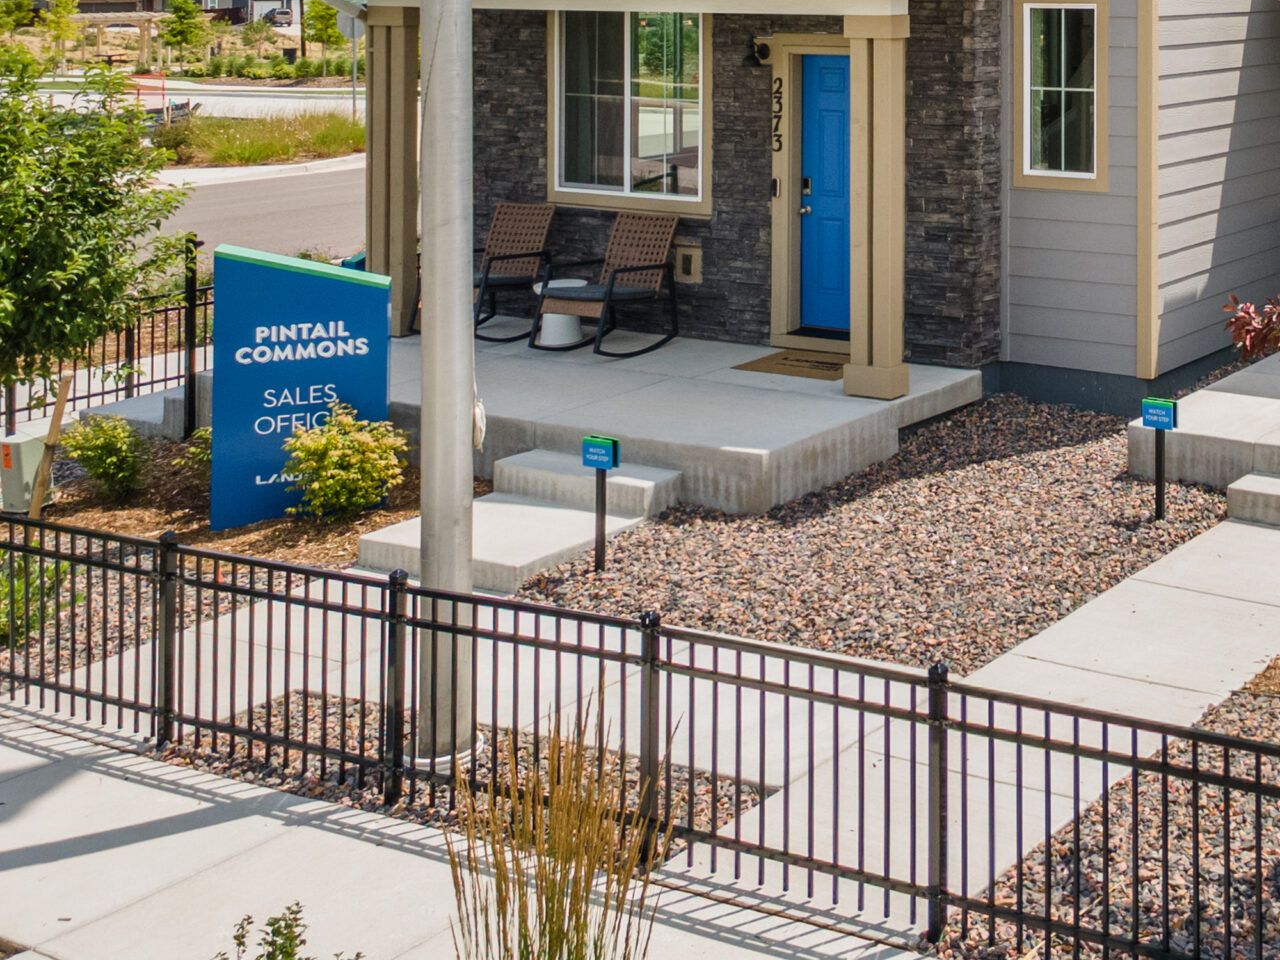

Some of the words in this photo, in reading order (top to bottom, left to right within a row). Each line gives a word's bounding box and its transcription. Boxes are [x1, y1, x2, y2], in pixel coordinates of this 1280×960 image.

[772, 77, 783, 152] 2373
[255, 320, 350, 344] PINTAIL
[235, 338, 370, 365] COMMONS
[263, 384, 338, 408] SALES
[254, 411, 338, 435] OFFIC
